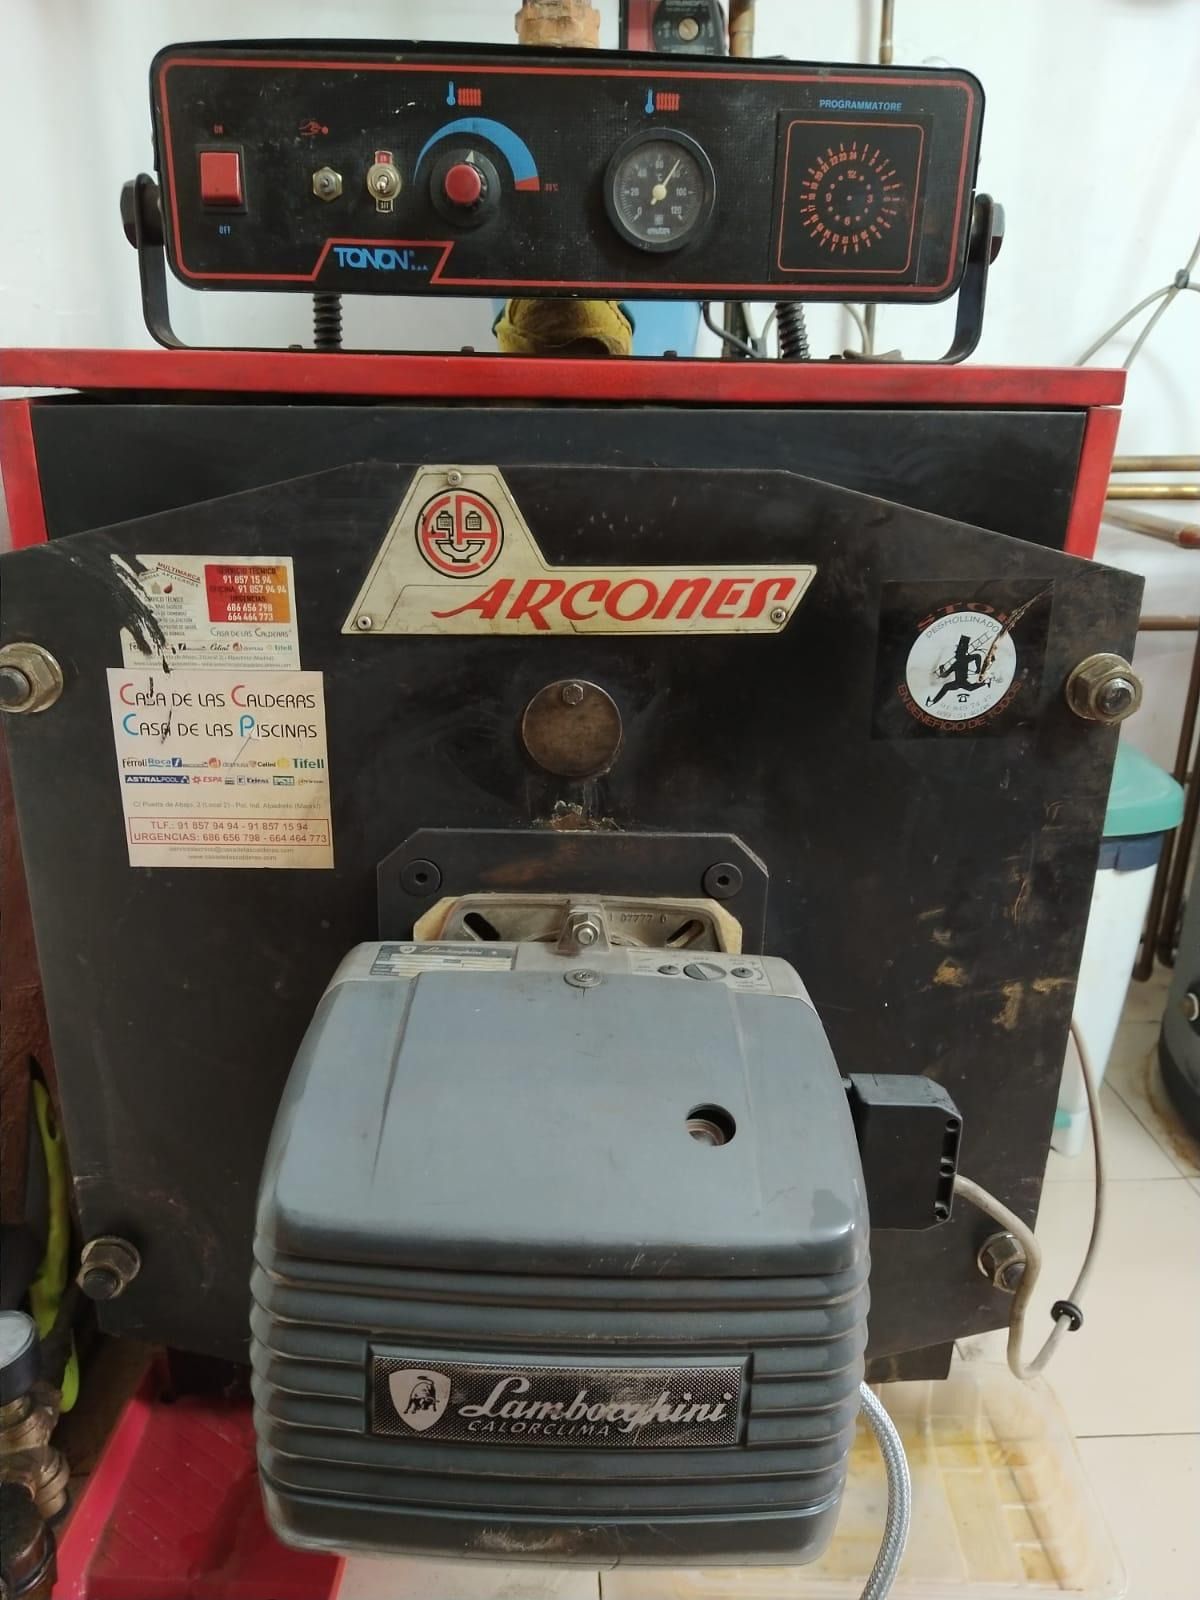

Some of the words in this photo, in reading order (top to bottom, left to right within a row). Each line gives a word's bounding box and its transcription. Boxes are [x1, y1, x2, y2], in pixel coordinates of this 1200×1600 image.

[819, 99, 902, 111] PROGRAMMATORE
[630, 187, 640, 197] 20
[676, 187, 688, 197] 100
[671, 206, 683, 215] 120
[333, 247, 409, 271] TONON
[157, 561, 201, 582] MULTIMARCA
[222, 575, 232, 585] 91
[234, 575, 249, 585] 857
[251, 576, 261, 585] 15
[262, 576, 272, 585] 94
[238, 585, 248, 594] 91
[249, 585, 264, 594] 857
[265, 586, 276, 594] 94
[277, 586, 287, 594] 94
[226, 603, 241, 613] 686
[242, 603, 257, 613] 656
[258, 604, 273, 613] 798
[431, 577, 797, 631] ARCONES
[227, 612, 242, 621] 664
[243, 612, 258, 621] 464
[258, 612, 274, 622] 773
[120, 682, 167, 707] CASA
[171, 692, 193, 707] DE
[198, 693, 226, 708] LAS
[231, 684, 316, 709] CALDERAS
[123, 713, 171, 737] CASA
[177, 722, 200, 737] DE
[205, 722, 234, 738] LAS
[240, 714, 318, 739] PISCINAS
[292, 758, 325, 769] Tifell
[126, 776, 180, 784] ASTRALPOOL
[203, 775, 223, 783] ESPA
[177, 821, 189, 830] 91
[192, 821, 209, 830] 857
[213, 822, 225, 830] 94
[248, 822, 259, 831] 91
[262, 822, 280, 831] 857
[283, 823, 295, 831] 15
[296, 823, 309, 831] 94
[133, 832, 201, 842] URGENCIAS:
[202, 833, 221, 842] 686
[222, 833, 240, 843] 656
[243, 834, 260, 843] 798
[269, 834, 286, 843] 664
[289, 834, 307, 843] 464
[309, 834, 328, 843] 773
[457, 1376, 736, 1434] Lamborghini
[467, 1419, 610, 1437] CALORCLIMA
